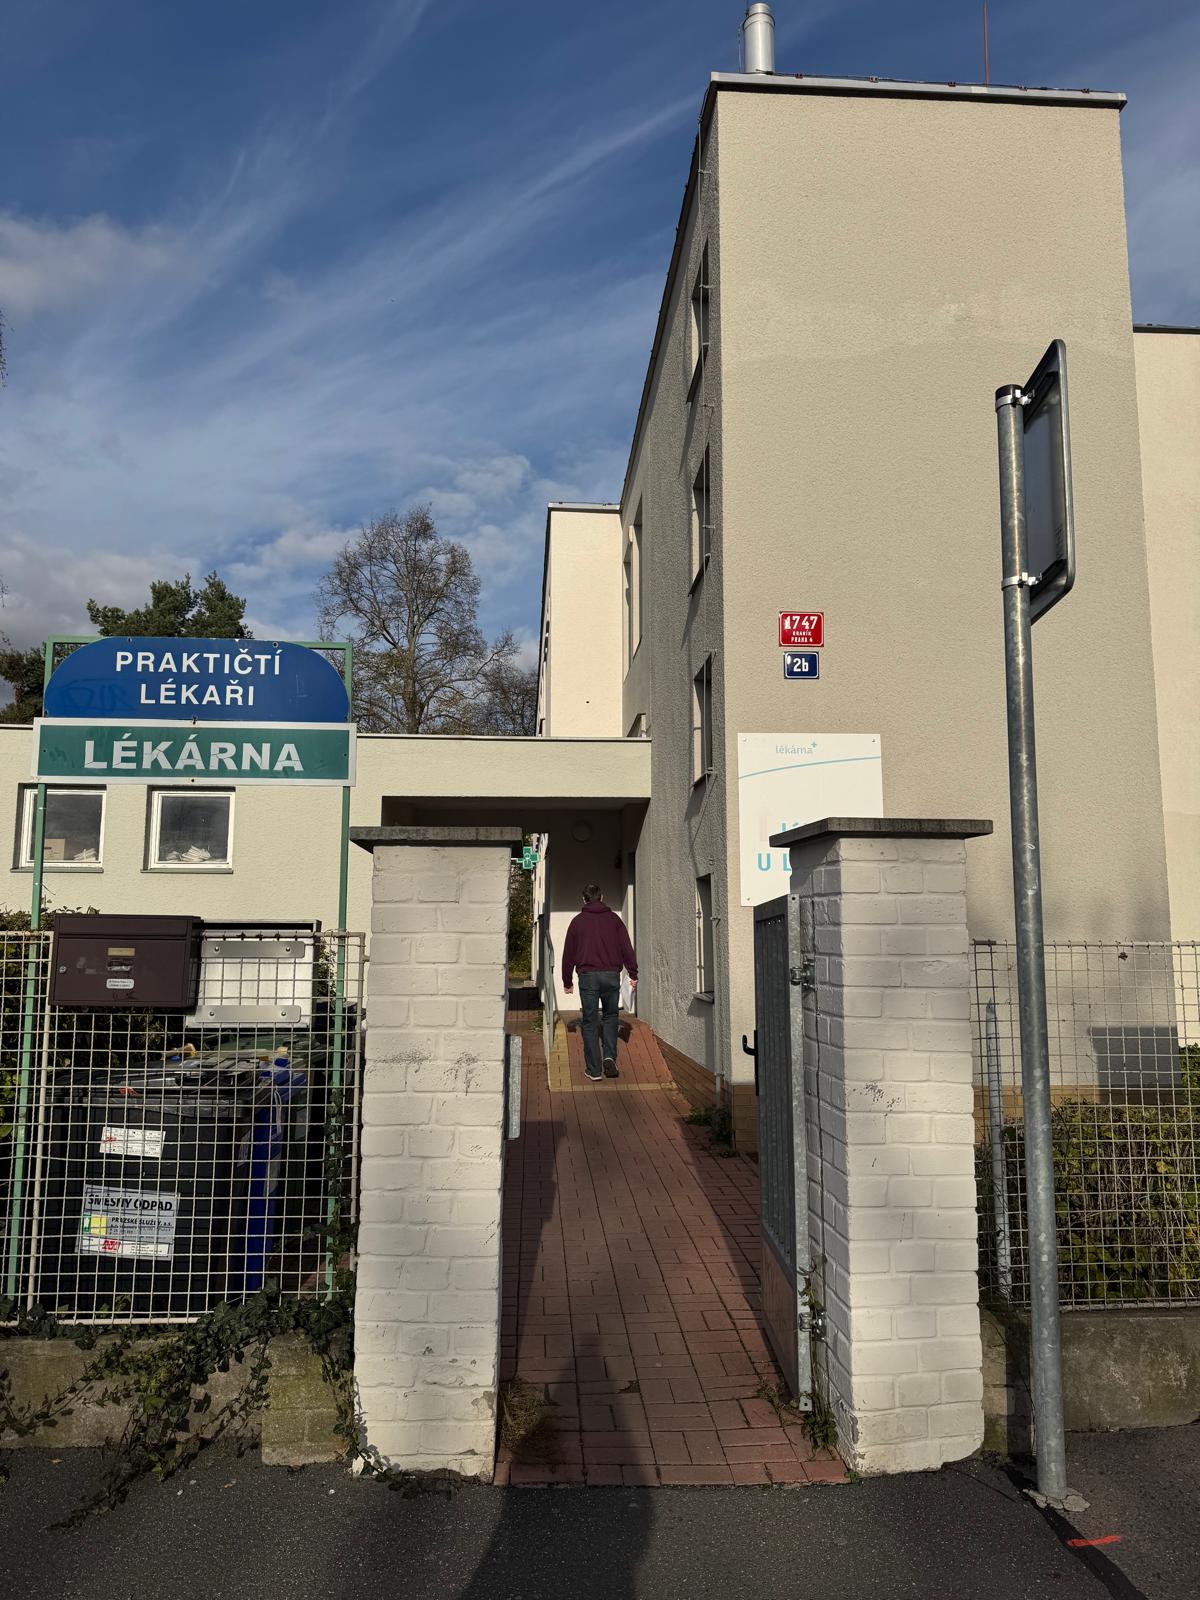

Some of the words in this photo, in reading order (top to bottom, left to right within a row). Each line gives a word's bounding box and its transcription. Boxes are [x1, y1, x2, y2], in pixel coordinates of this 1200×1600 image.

[784, 615, 818, 630] 1747
[115, 648, 282, 676] PRAKTIČTÍ
[793, 657, 809, 672] 2b
[139, 678, 254, 706] LÉKAŘI
[83, 732, 305, 772] LÉKÁRNA
[133, 1198, 173, 1211] ODPAD
